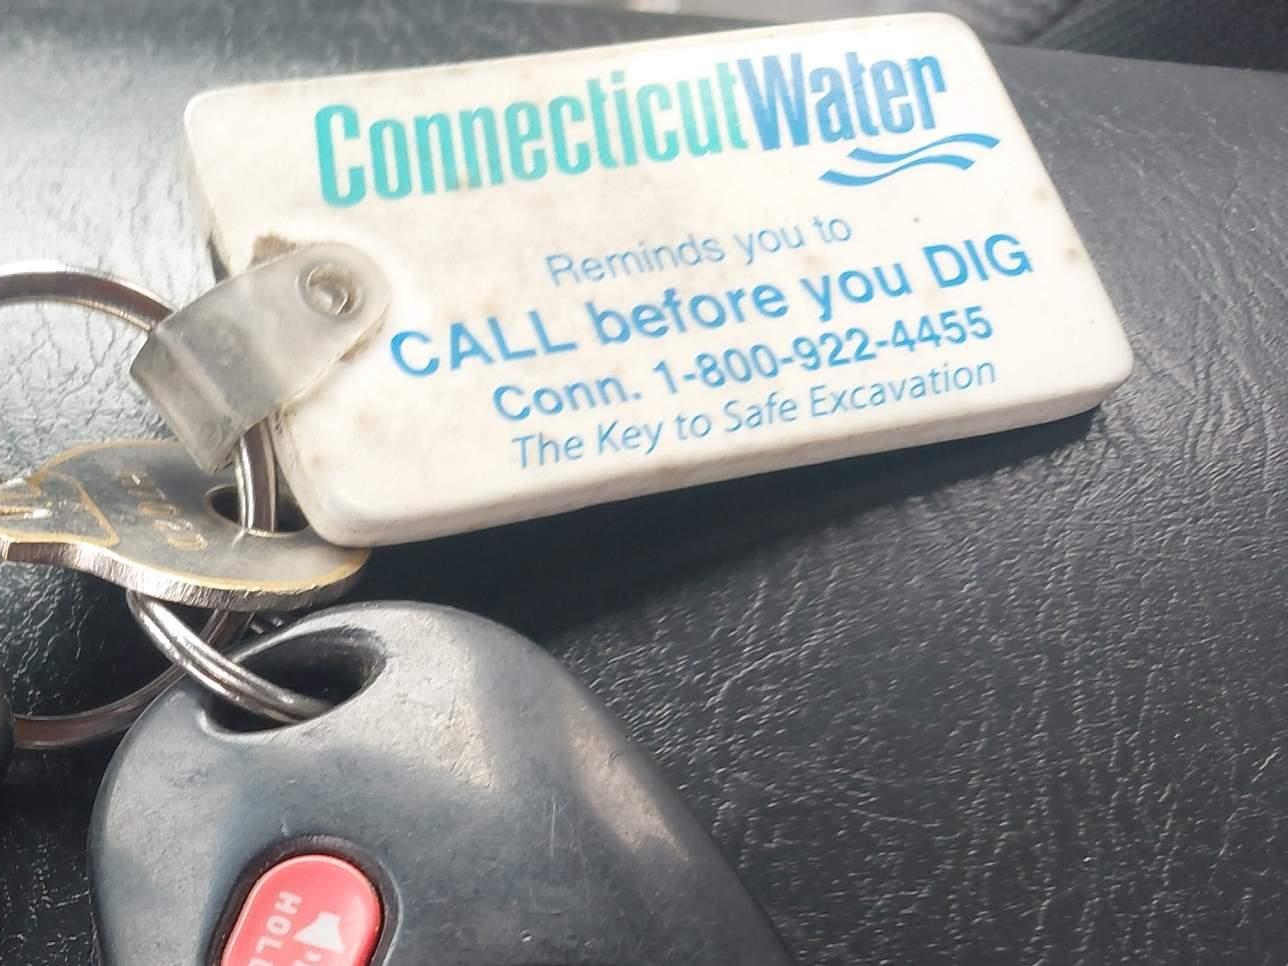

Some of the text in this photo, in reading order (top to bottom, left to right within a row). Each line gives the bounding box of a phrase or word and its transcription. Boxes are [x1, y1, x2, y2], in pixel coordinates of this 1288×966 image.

[388, 232, 1034, 379] CALL before you DIG
[546, 217, 852, 285] Reminds you to
[492, 305, 994, 422] Conn. 1-800-922-4455
[513, 356, 997, 472] The Key to Safe Excavation
